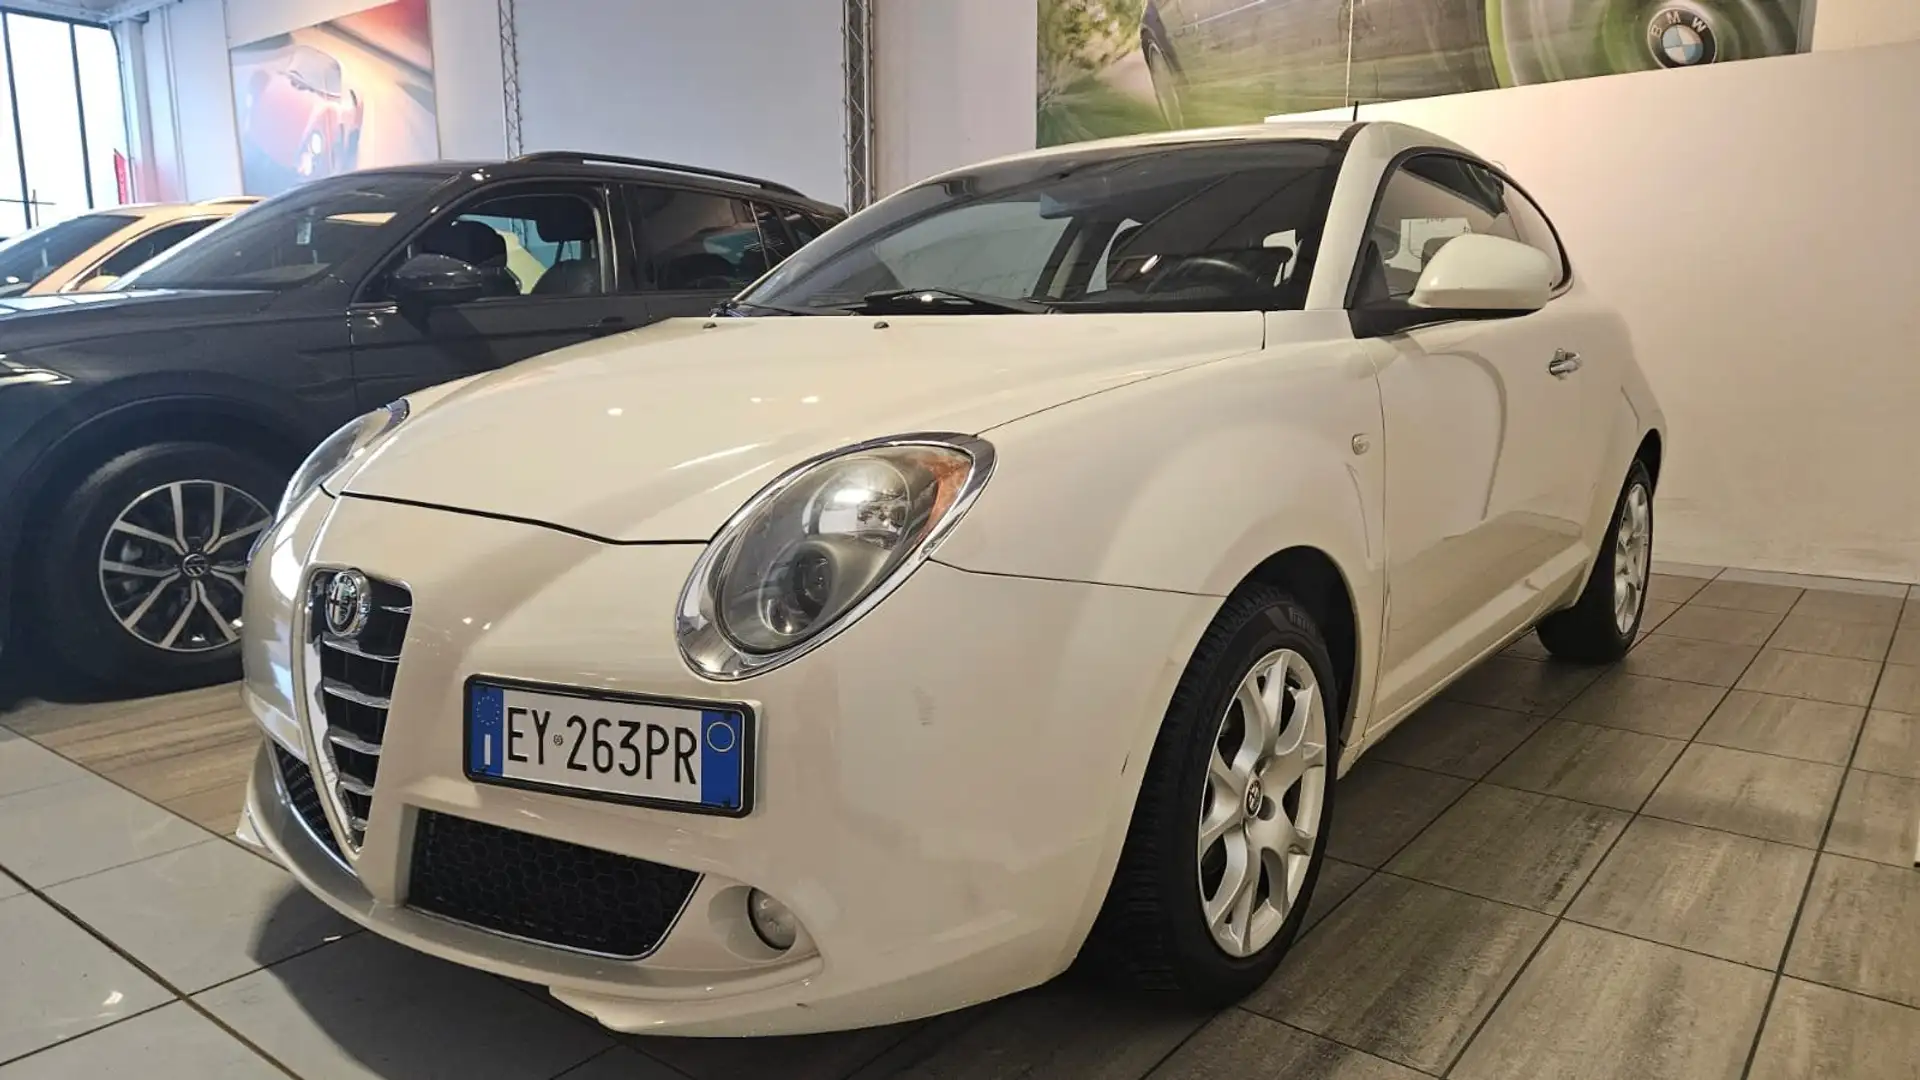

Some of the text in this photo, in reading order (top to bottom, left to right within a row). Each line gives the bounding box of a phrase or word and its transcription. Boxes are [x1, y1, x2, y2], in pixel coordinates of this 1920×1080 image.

[1650, 10, 1707, 38] BMW
[507, 706, 698, 785] EY 263PR
